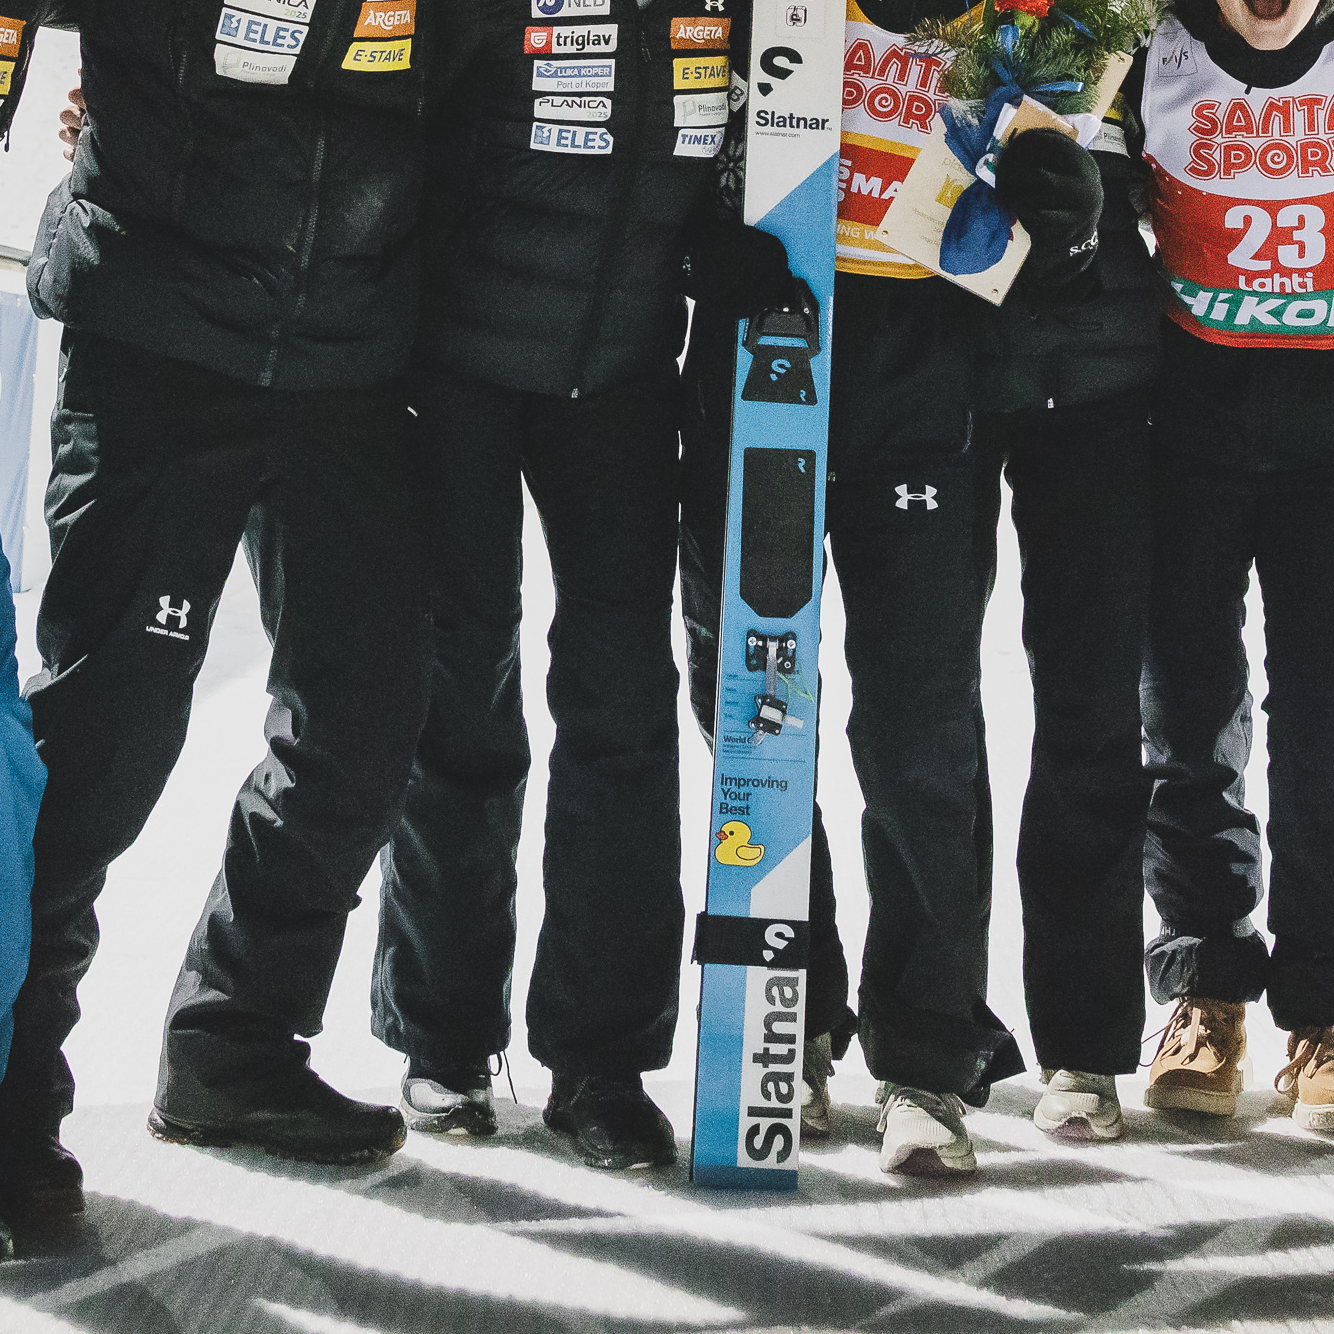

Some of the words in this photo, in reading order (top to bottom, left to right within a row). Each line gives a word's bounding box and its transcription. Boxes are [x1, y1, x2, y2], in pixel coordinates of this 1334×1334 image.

[284, 8, 308, 19] 2025
[364, 9, 411, 30] ARGETA
[244, 19, 303, 49] ELES
[555, 30, 612, 51] triglav
[676, 24, 723, 43] ARGETA
[242, 61, 287, 73] Plinovodi
[557, 67, 579, 76] LUKA
[580, 67, 610, 76] KOPER
[843, 37, 951, 93] ANT
[556, 80, 573, 88] Port
[574, 80, 583, 88] of
[585, 79, 609, 90] Koper
[539, 98, 608, 109] PLANICA
[842, 77, 949, 134] POR
[755, 109, 829, 131] Slatnar
[556, 128, 610, 150] ELES
[681, 133, 717, 146] TINEX
[1224, 204, 1326, 271] 23
[1238, 272, 1314, 293] Lahti
[723, 735, 746, 744] World
[720, 773, 788, 792] Improving
[720, 788, 753, 802] Your
[719, 802, 751, 816] Best
[745, 966, 804, 1164] Slatna
